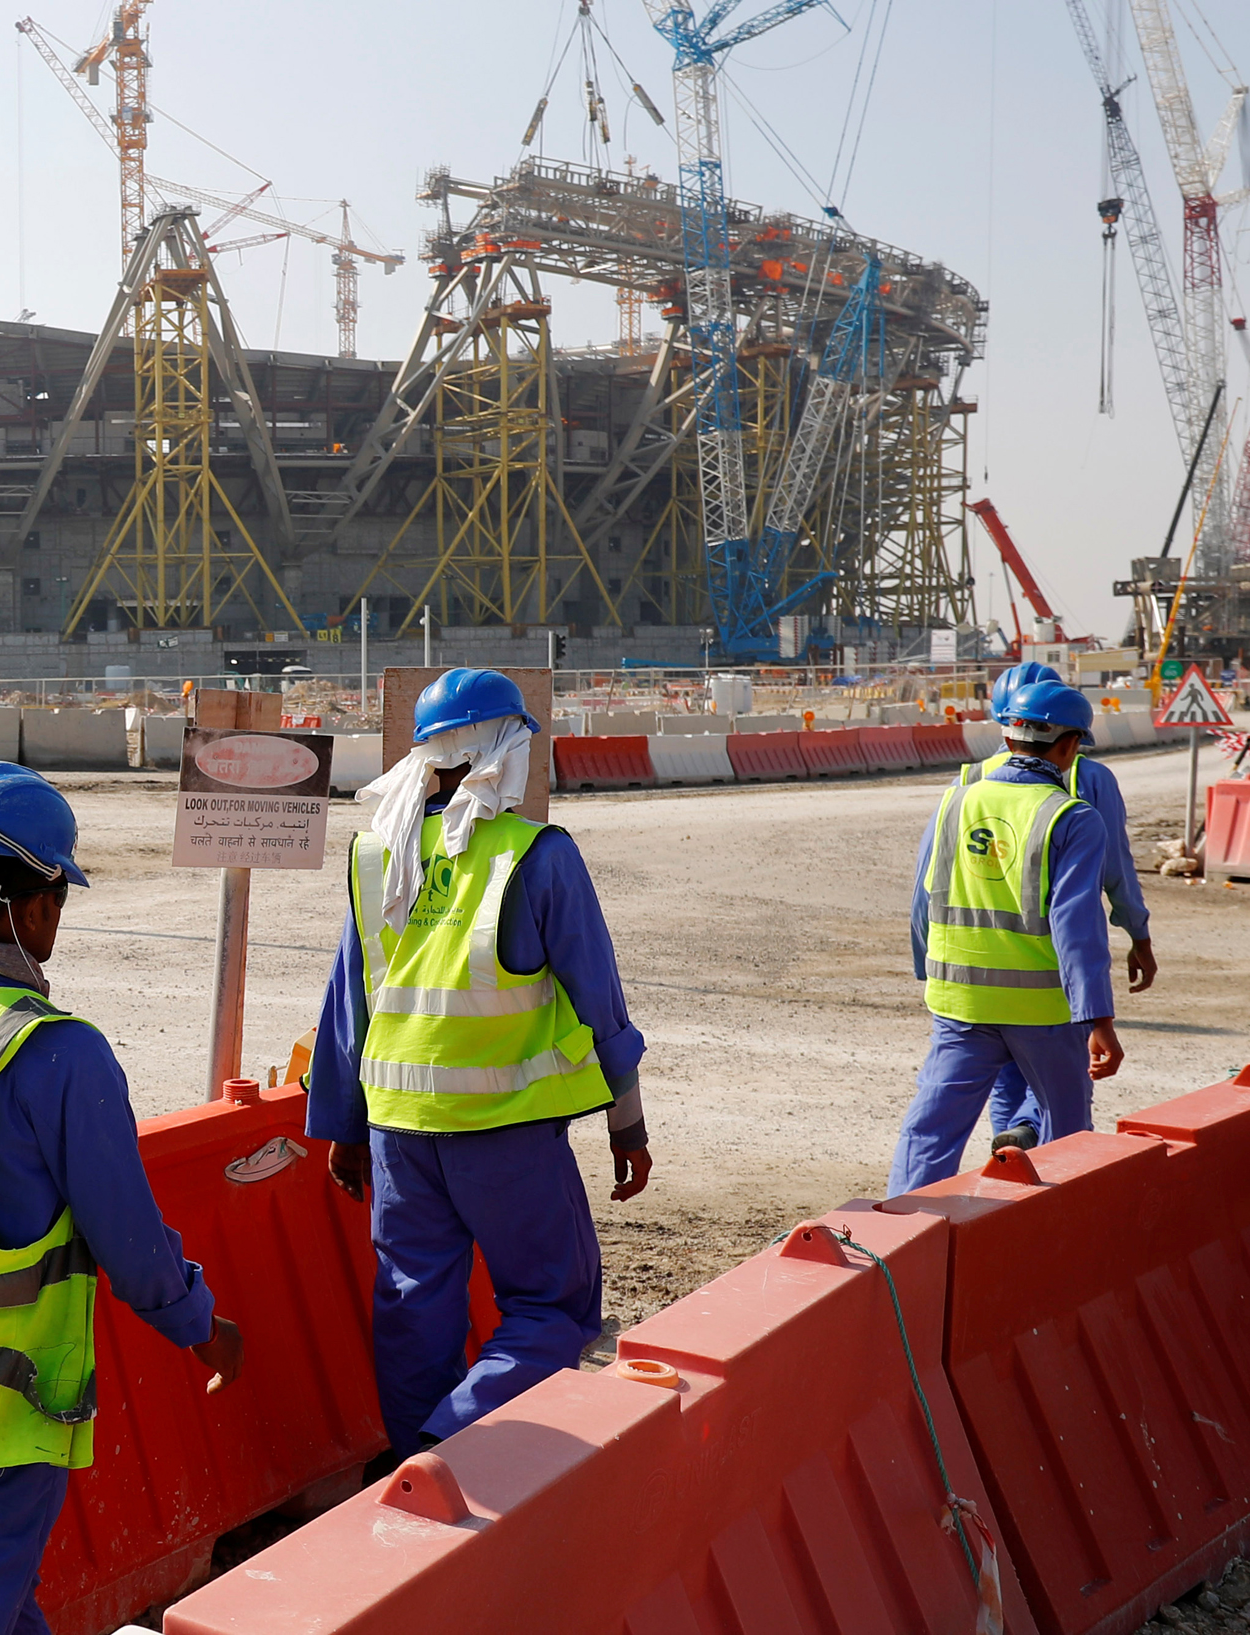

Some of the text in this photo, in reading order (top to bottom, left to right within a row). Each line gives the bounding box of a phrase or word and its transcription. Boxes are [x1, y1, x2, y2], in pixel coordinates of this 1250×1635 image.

[185, 798, 208, 811] LOOK
[247, 801, 280, 813] MOVING
[282, 802, 321, 815] VEHICLES
[193, 815, 231, 829] تتحرك
[233, 816, 273, 831] مركبات
[248, 834, 257, 847] से
[424, 917, 430, 926] &
